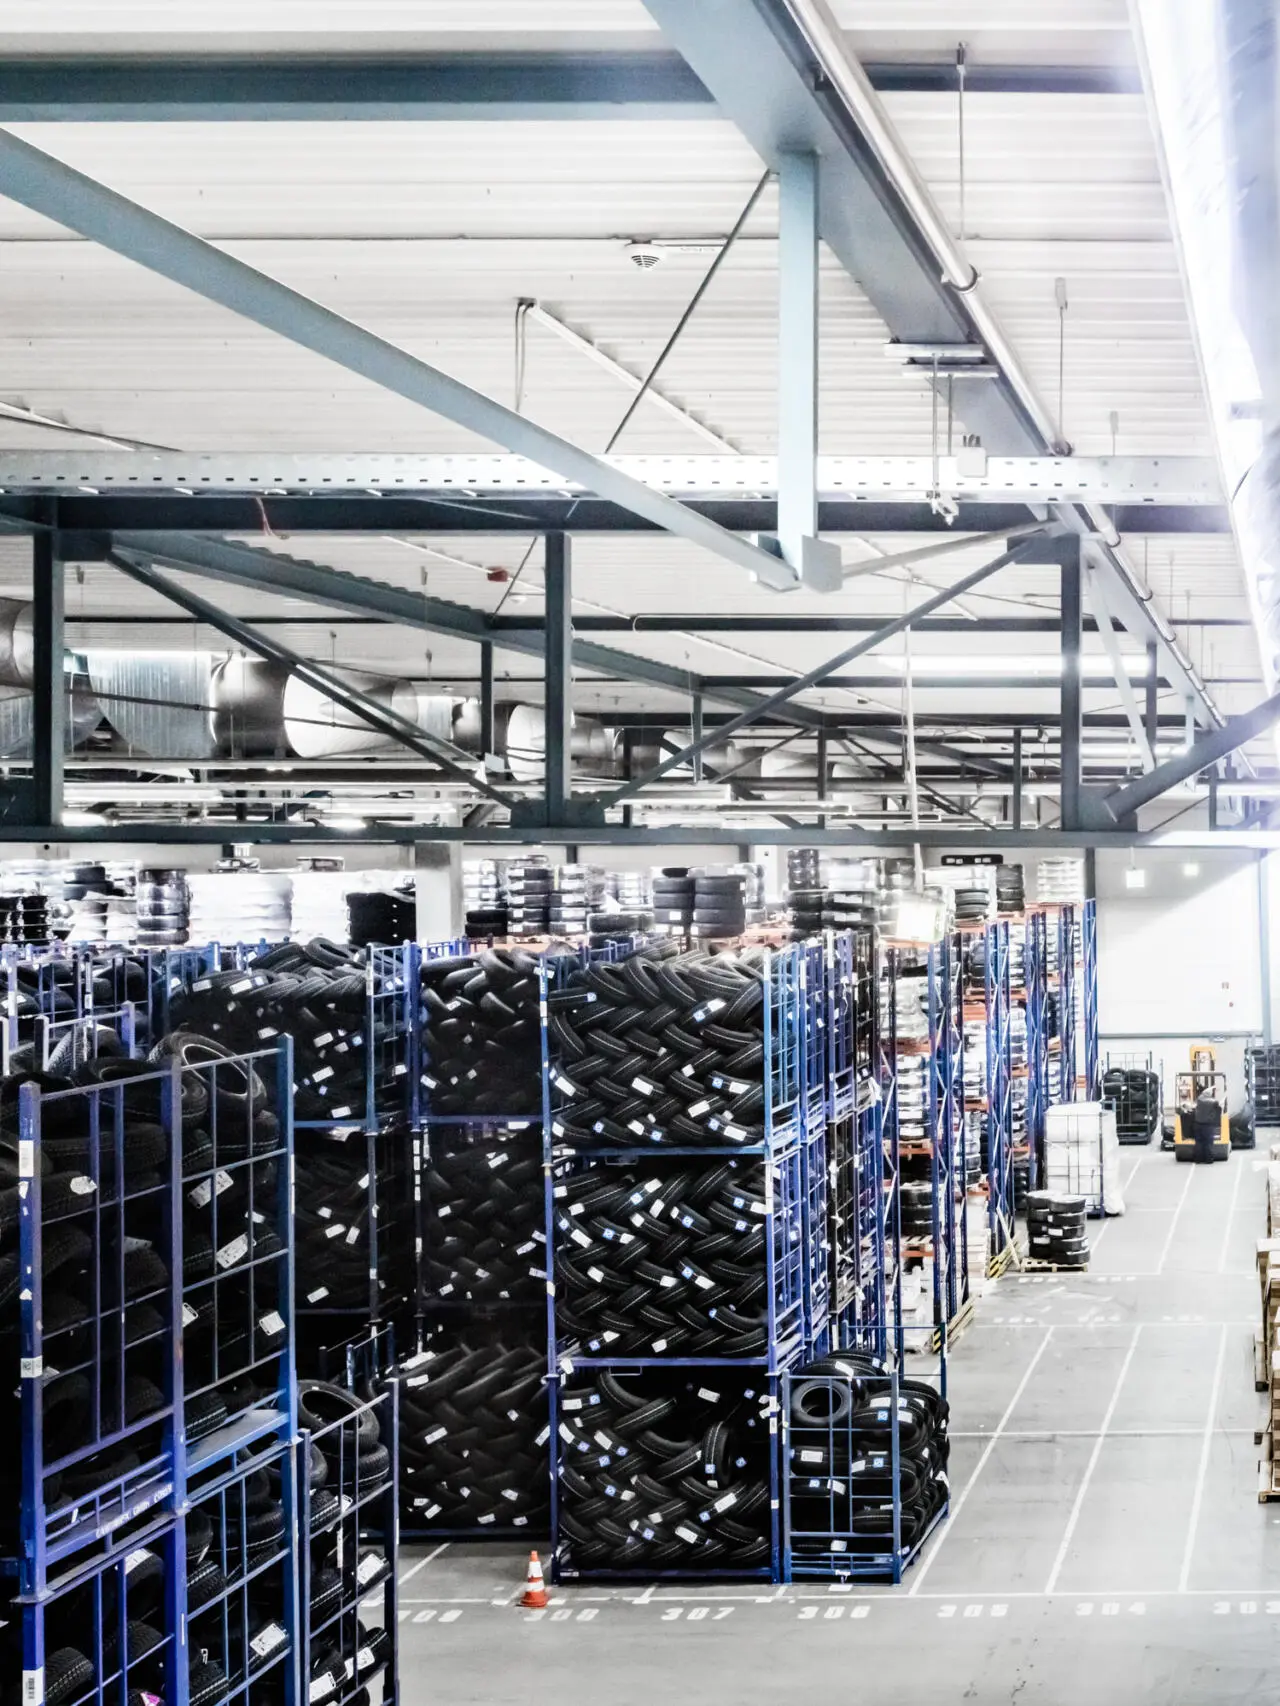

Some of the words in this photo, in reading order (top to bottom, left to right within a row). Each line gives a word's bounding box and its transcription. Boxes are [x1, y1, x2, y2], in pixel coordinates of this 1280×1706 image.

[661, 1607, 736, 1620] 307
[797, 1606, 871, 1619] 306
[936, 1604, 1010, 1618] 305
[1075, 1602, 1147, 1616] 304
